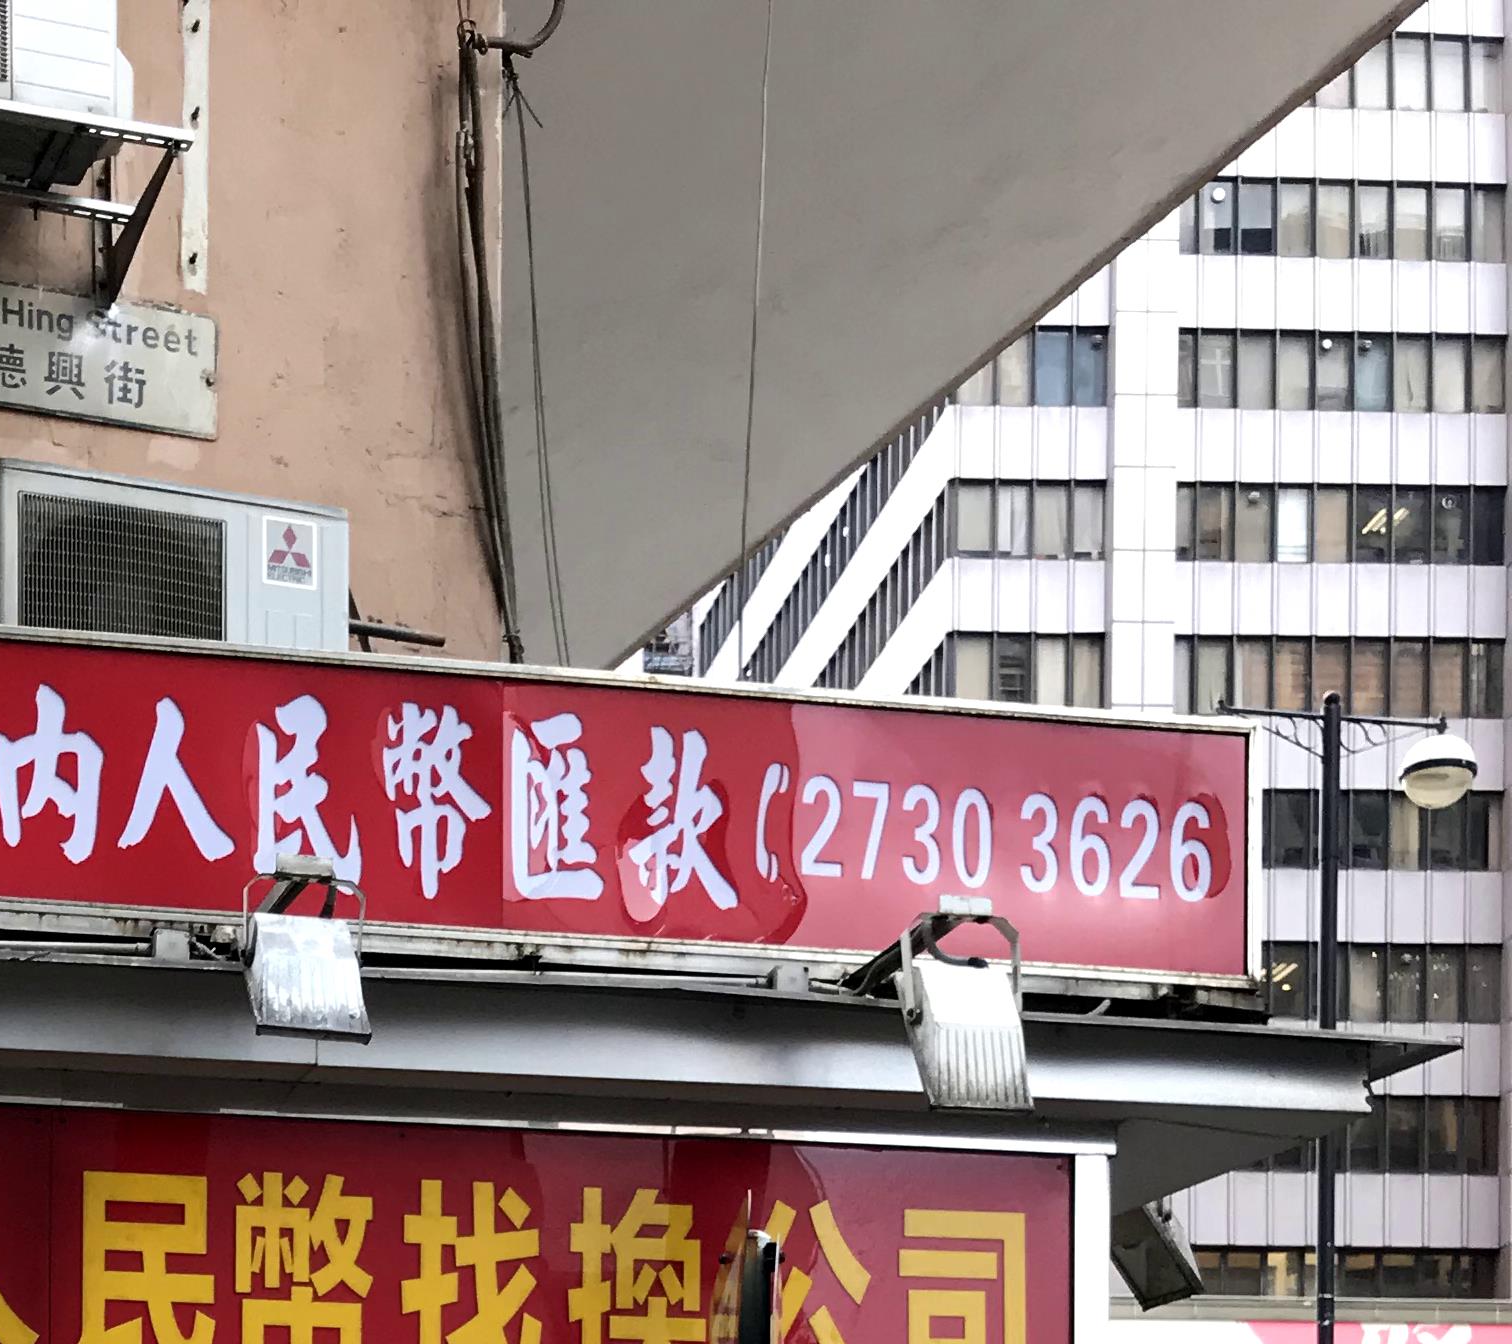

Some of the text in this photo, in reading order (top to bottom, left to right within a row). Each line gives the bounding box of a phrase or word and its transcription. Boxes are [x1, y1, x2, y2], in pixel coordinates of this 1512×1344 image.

[1, 297, 74, 340] Hing
[87, 308, 199, 357] Street
[799, 772, 991, 890] 2730
[1017, 790, 1214, 907] 3626
